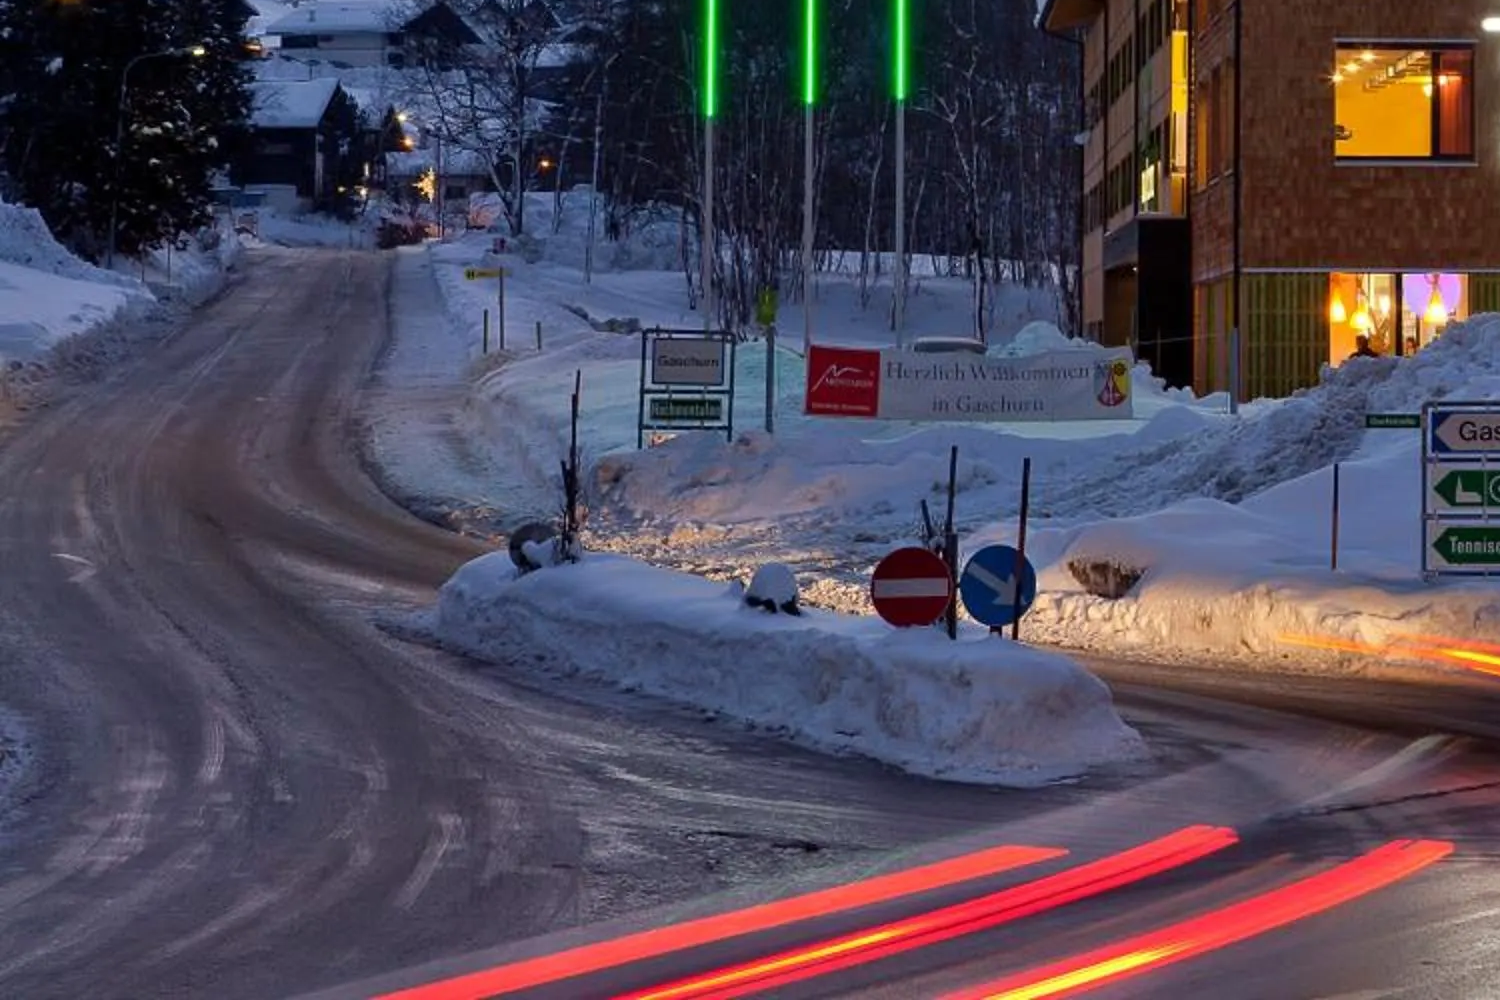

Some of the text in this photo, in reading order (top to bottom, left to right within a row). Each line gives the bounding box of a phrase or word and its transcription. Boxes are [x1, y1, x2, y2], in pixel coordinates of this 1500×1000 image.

[658, 354, 719, 368] Gaschurn
[886, 361, 1089, 382] Herzlich Willkommen
[931, 396, 1045, 414] in Gaschurn
